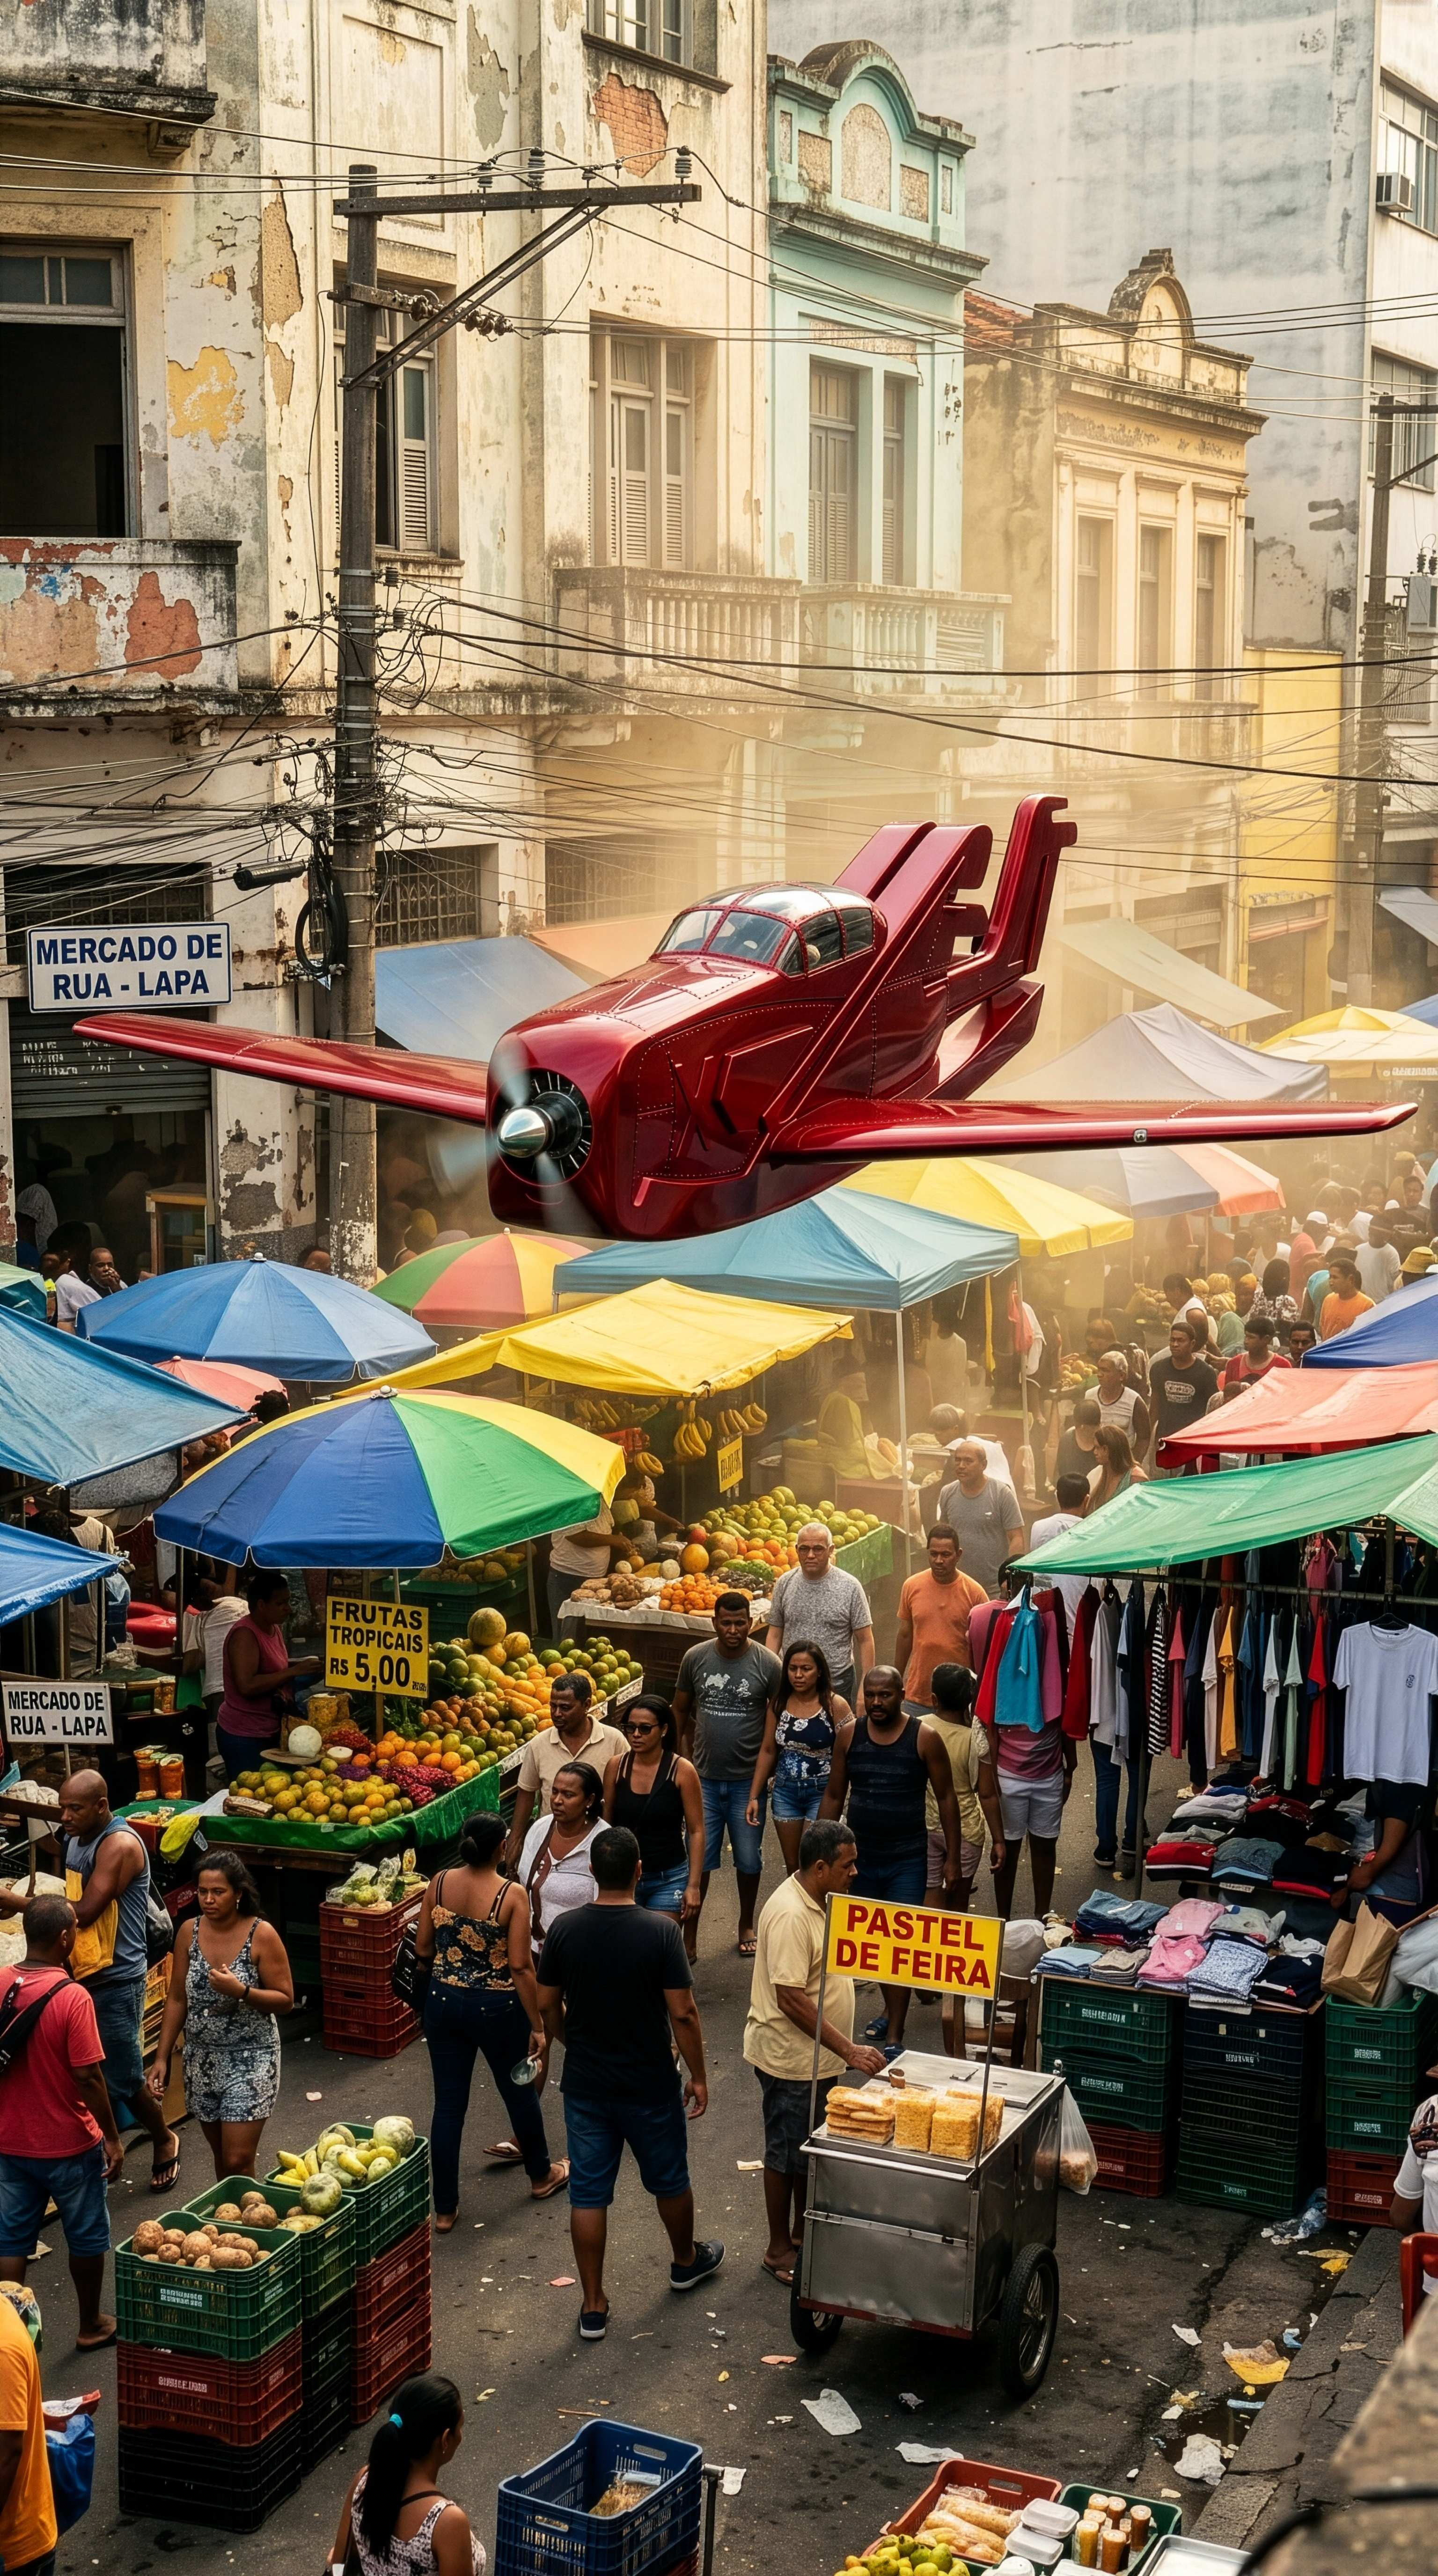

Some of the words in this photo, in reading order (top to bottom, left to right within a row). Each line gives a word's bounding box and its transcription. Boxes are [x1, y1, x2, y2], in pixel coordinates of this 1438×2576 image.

[37, 935, 177, 965] MERCADO
[187, 933, 223, 959] DE
[53, 973, 112, 1000] RUA
[138, 969, 210, 996] LAPA
[331, 1601, 423, 1630] FRUTAS
[330, 1625, 423, 1653] TROPICAIS
[8, 1691, 80, 1710] MERCADO
[84, 1692, 104, 1711] DE
[10, 1716, 46, 1735] RUA
[62, 1716, 108, 1736] LAPA
[847, 1904, 984, 1951] PASTEL
[836, 1938, 880, 1972] DE
[891, 1946, 990, 1989] FEIRA
